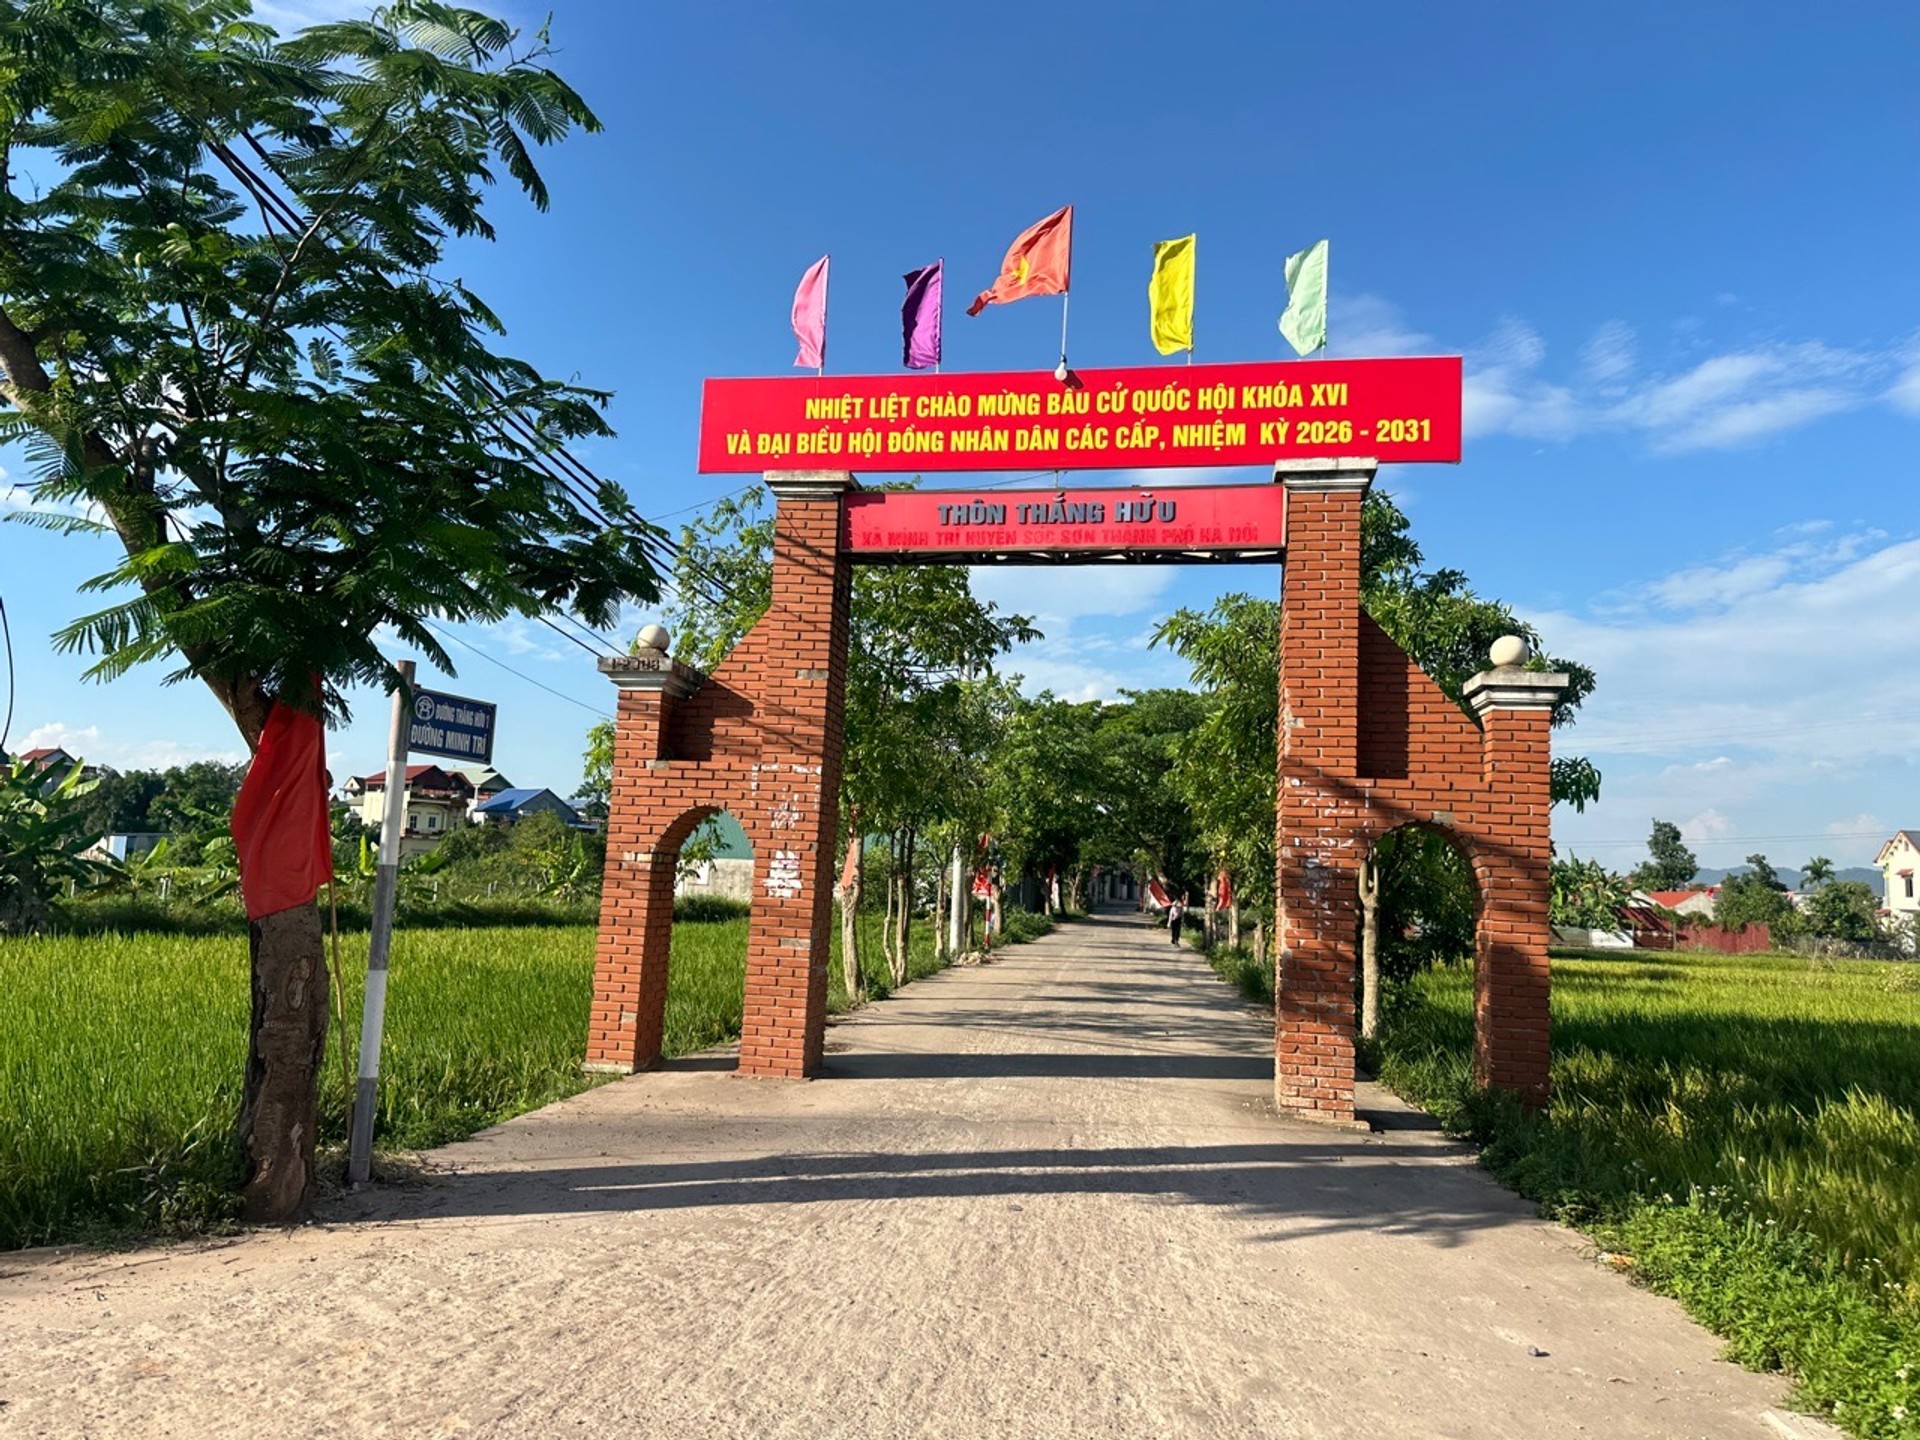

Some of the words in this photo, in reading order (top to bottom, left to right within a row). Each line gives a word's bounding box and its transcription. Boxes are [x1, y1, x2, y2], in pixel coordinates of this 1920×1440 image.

[805, 393, 863, 424] NHIỆT
[869, 393, 911, 423] LIỆT
[916, 390, 971, 418] CHÀO
[977, 388, 1041, 417] MỪNG
[1046, 386, 1090, 415] BẦU
[1096, 381, 1129, 414] CỬ
[1132, 380, 1190, 414] QUỐC
[1198, 382, 1235, 415] HỘI
[1242, 380, 1304, 410] KHÓA
[1310, 383, 1348, 407] XVI
[727, 428, 751, 455] VÀ
[757, 432, 790, 459] ĐẠI
[848, 427, 882, 459] HỘI
[887, 424, 944, 454] ĐỒNG
[950, 425, 1009, 452] NHÂN
[1016, 424, 1059, 451] DÂN
[1065, 422, 1108, 450] CÁC
[1115, 419, 1165, 451] CẤP,
[1172, 419, 1246, 452] NHIỆM
[1260, 417, 1290, 445] KỲ
[1296, 420, 1353, 444] 2026
[1376, 418, 1432, 443] 2031
[938, 499, 1007, 526] THÔN
[1015, 491, 1106, 525] THẮNG
[1114, 491, 1177, 523] HỮU
[1023, 526, 1056, 545] SÓC
[1060, 528, 1096, 545] SƠN
[1101, 525, 1158, 545] THÀNH
[411, 722, 443, 747] ĐƯỜNG
[446, 731, 470, 752] MINH
[472, 733, 487, 755] TRÍ
